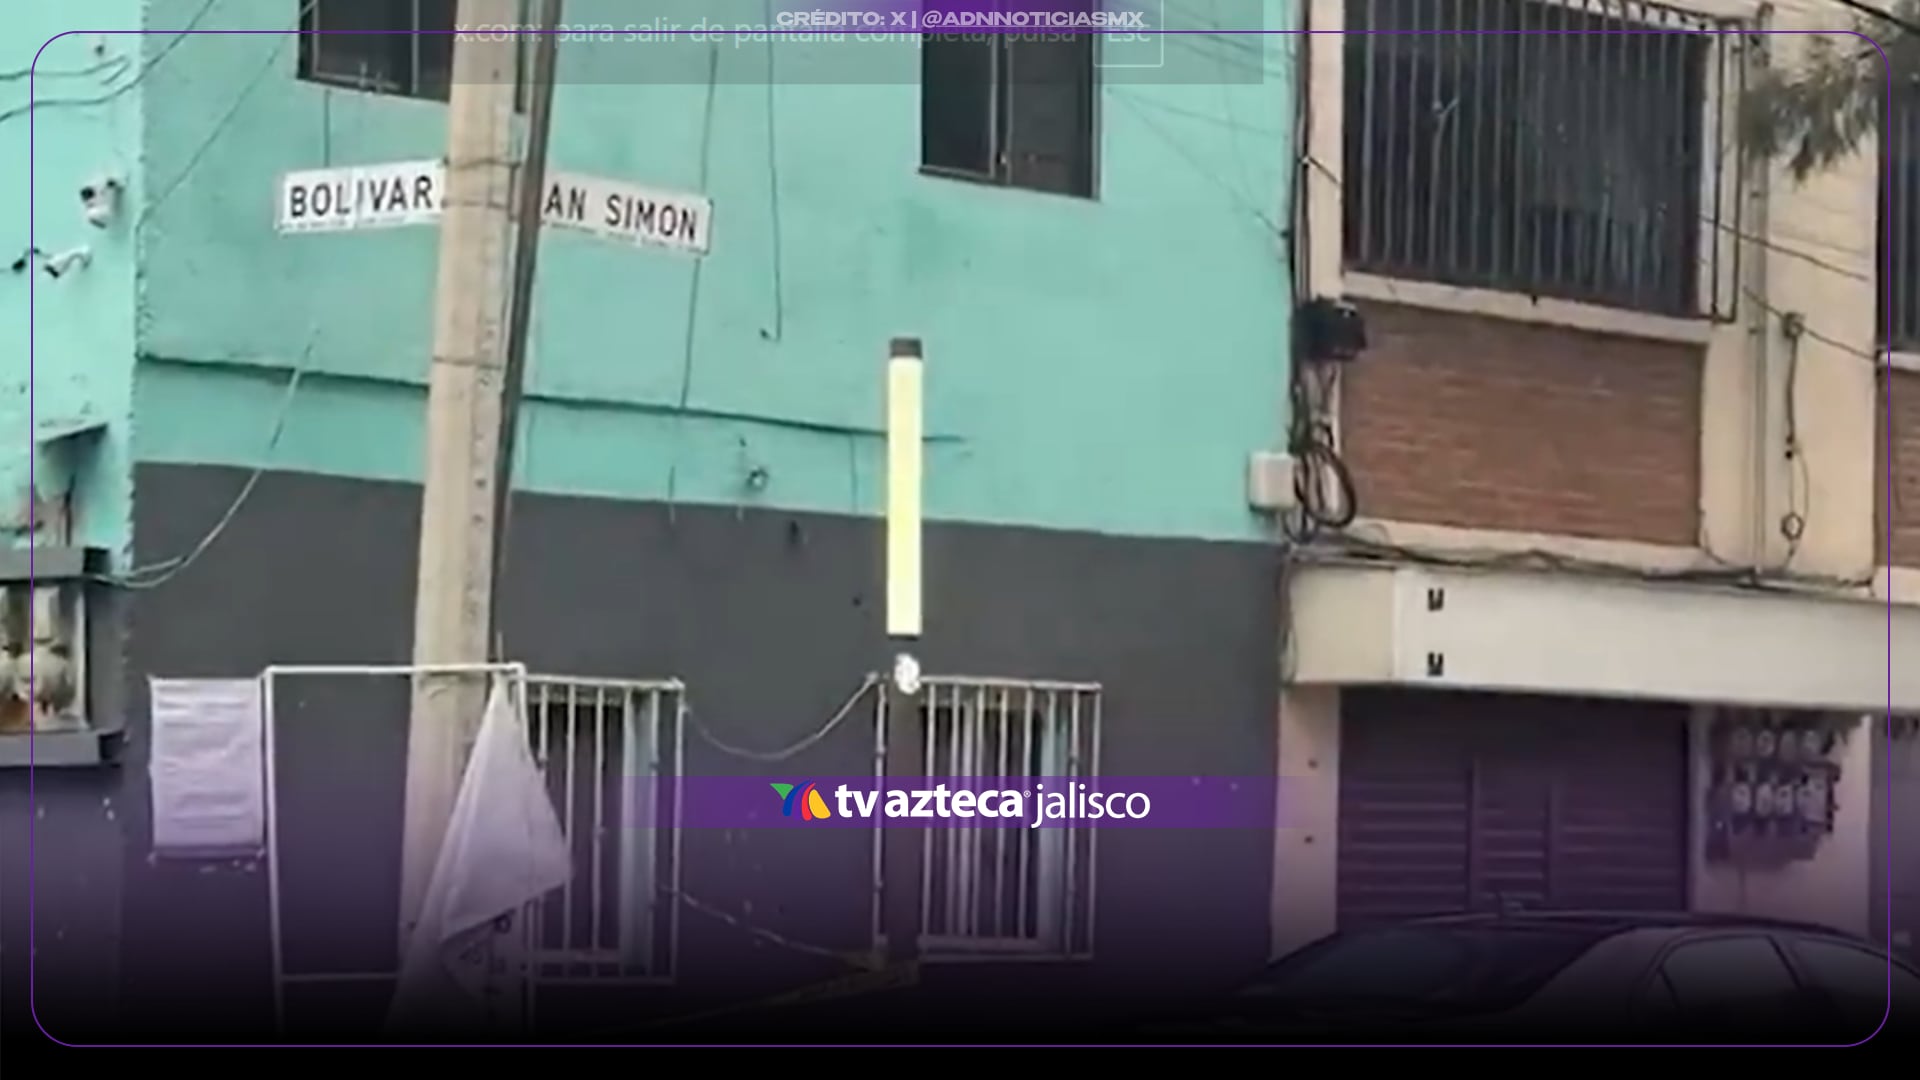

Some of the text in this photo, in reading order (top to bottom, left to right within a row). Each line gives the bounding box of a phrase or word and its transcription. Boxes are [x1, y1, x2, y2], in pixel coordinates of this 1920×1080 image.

[291, 175, 433, 218] BOLIVAR
[544, 182, 586, 221] AN
[605, 193, 696, 243] SIMON
